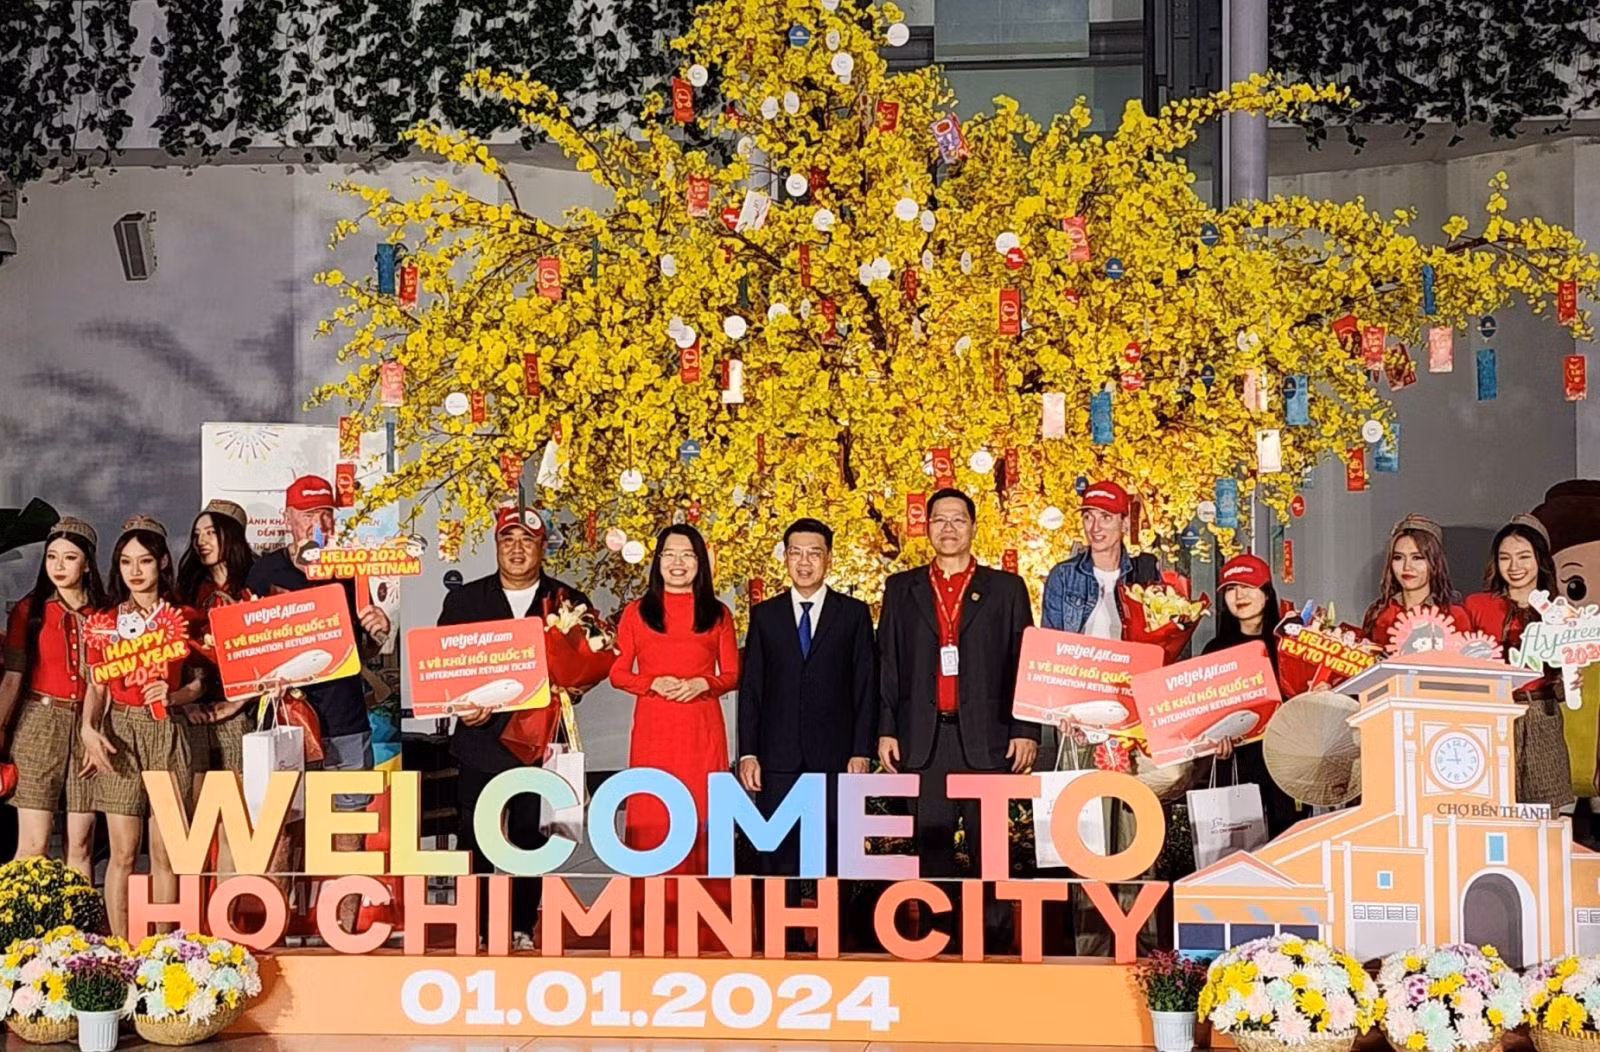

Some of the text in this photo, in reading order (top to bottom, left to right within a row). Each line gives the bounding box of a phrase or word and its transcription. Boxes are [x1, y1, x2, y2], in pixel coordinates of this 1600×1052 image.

[309, 561, 420, 577] FLY TO VIETNAM
[321, 550, 369, 564] HELLO
[105, 628, 165, 660] HAPPY
[232, 642, 284, 660] INTERNATION
[284, 635, 317, 649] RETURN
[316, 629, 343, 642] TICKET
[1281, 639, 1363, 677] FLY TO VIETN
[1298, 630, 1377, 667] HELLO 2024
[1561, 643, 1600, 665] 202
[94, 641, 187, 682] NEW YEAR
[124, 662, 168, 687] 2024
[425, 668, 477, 680] INTERNATION
[478, 664, 510, 675] RETURN
[511, 661, 536, 672] TICKET
[1032, 674, 1086, 689] INTERNATION
[1087, 682, 1120, 694] RETURN
[1157, 703, 1210, 727] INTERNATION
[1209, 695, 1241, 711] RETURN
[1241, 688, 1268, 702] TICKET
[142, 767, 1166, 882] WELCOME TO
[1436, 803, 1470, 817] CHỢ
[1471, 801, 1499, 817] BẾN
[127, 874, 1169, 964] HO CHI MINH CITY
[401, 969, 900, 1032] 01.01.2024
